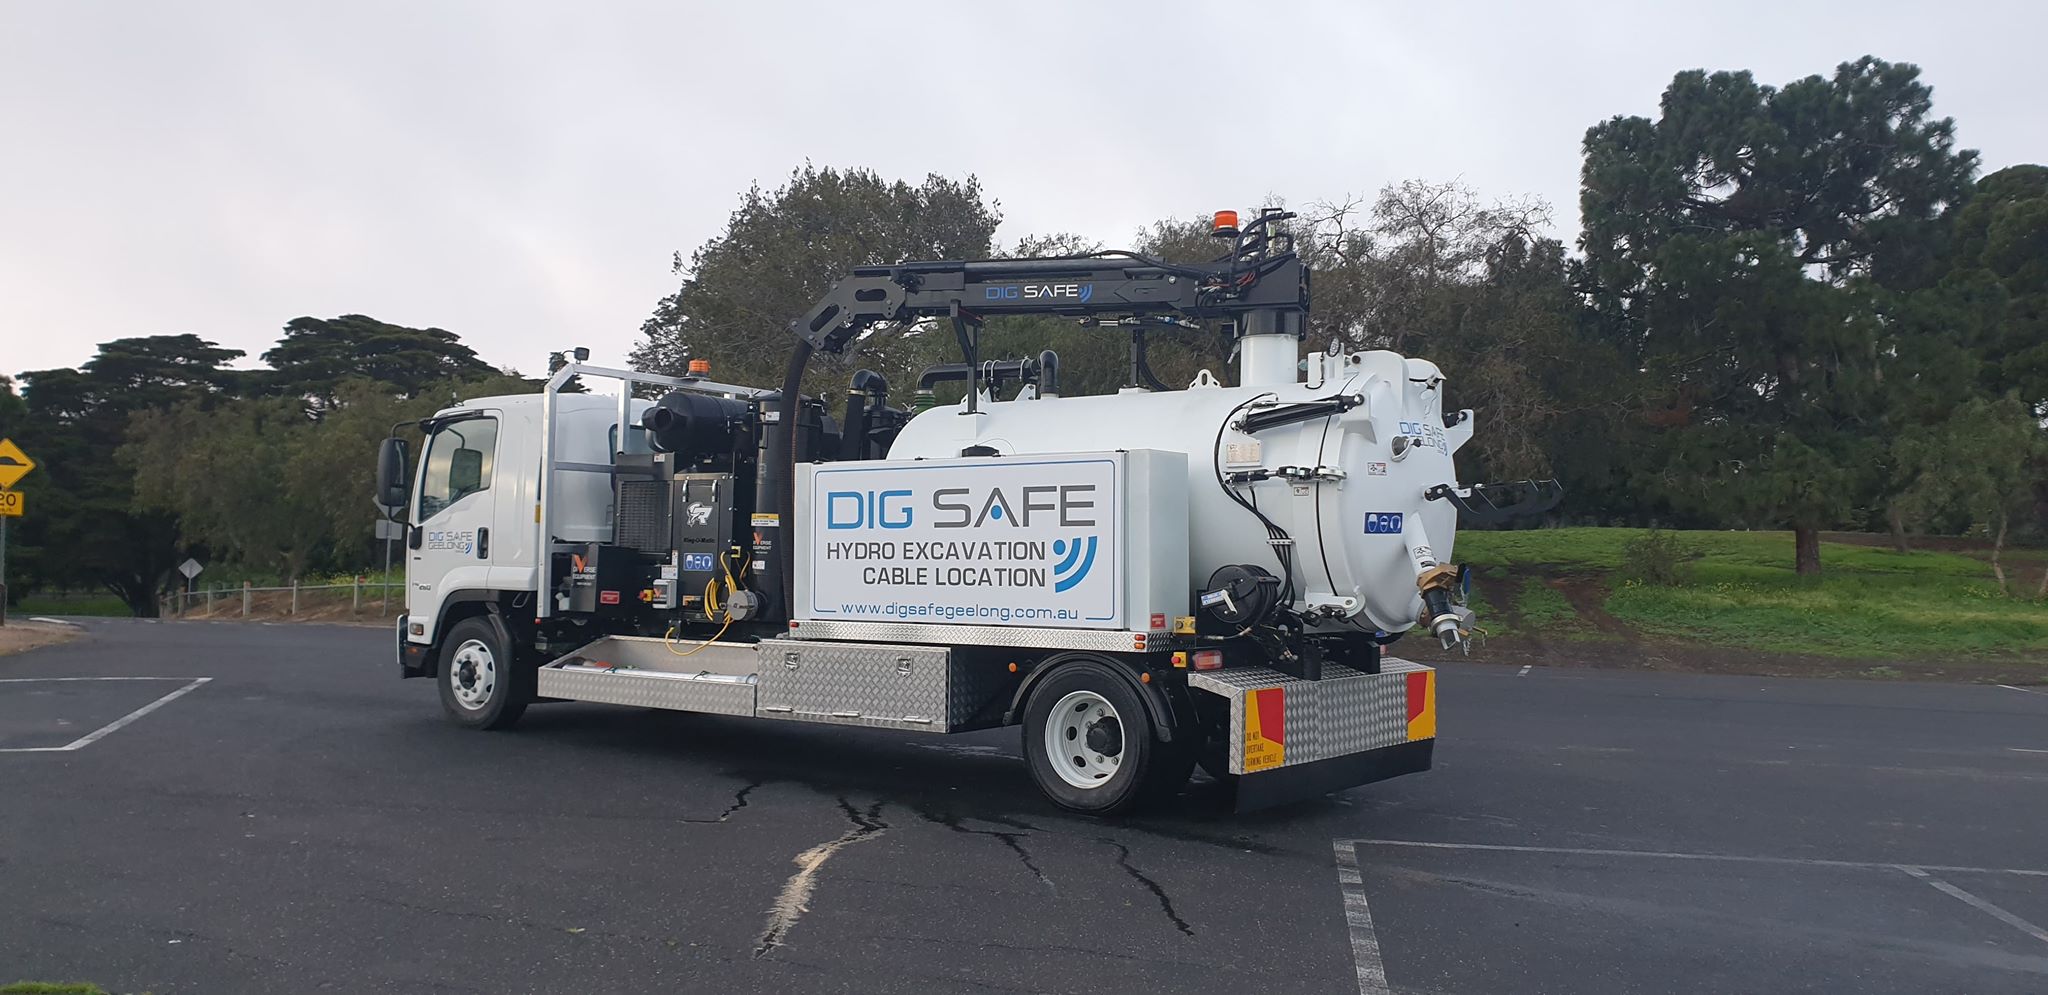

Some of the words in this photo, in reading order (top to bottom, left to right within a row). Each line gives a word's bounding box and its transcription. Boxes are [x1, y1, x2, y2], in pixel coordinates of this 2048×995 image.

[986, 286, 1018, 299] DIG
[1024, 284, 1079, 298] SAFE
[1400, 421, 1422, 435] DIG
[827, 489, 913, 530] DIG
[932, 484, 1096, 529] SAFE
[429, 531, 444, 542] DIG
[446, 531, 472, 542] SAFE
[428, 541, 465, 550] GEELONG
[826, 542, 896, 561] HYDRO
[902, 541, 1046, 561] EXCAVATION
[862, 567, 928, 586] CABLE
[935, 567, 1046, 587] LOCATION
[841, 602, 1079, 621] www.digsafegeelong.com.au
